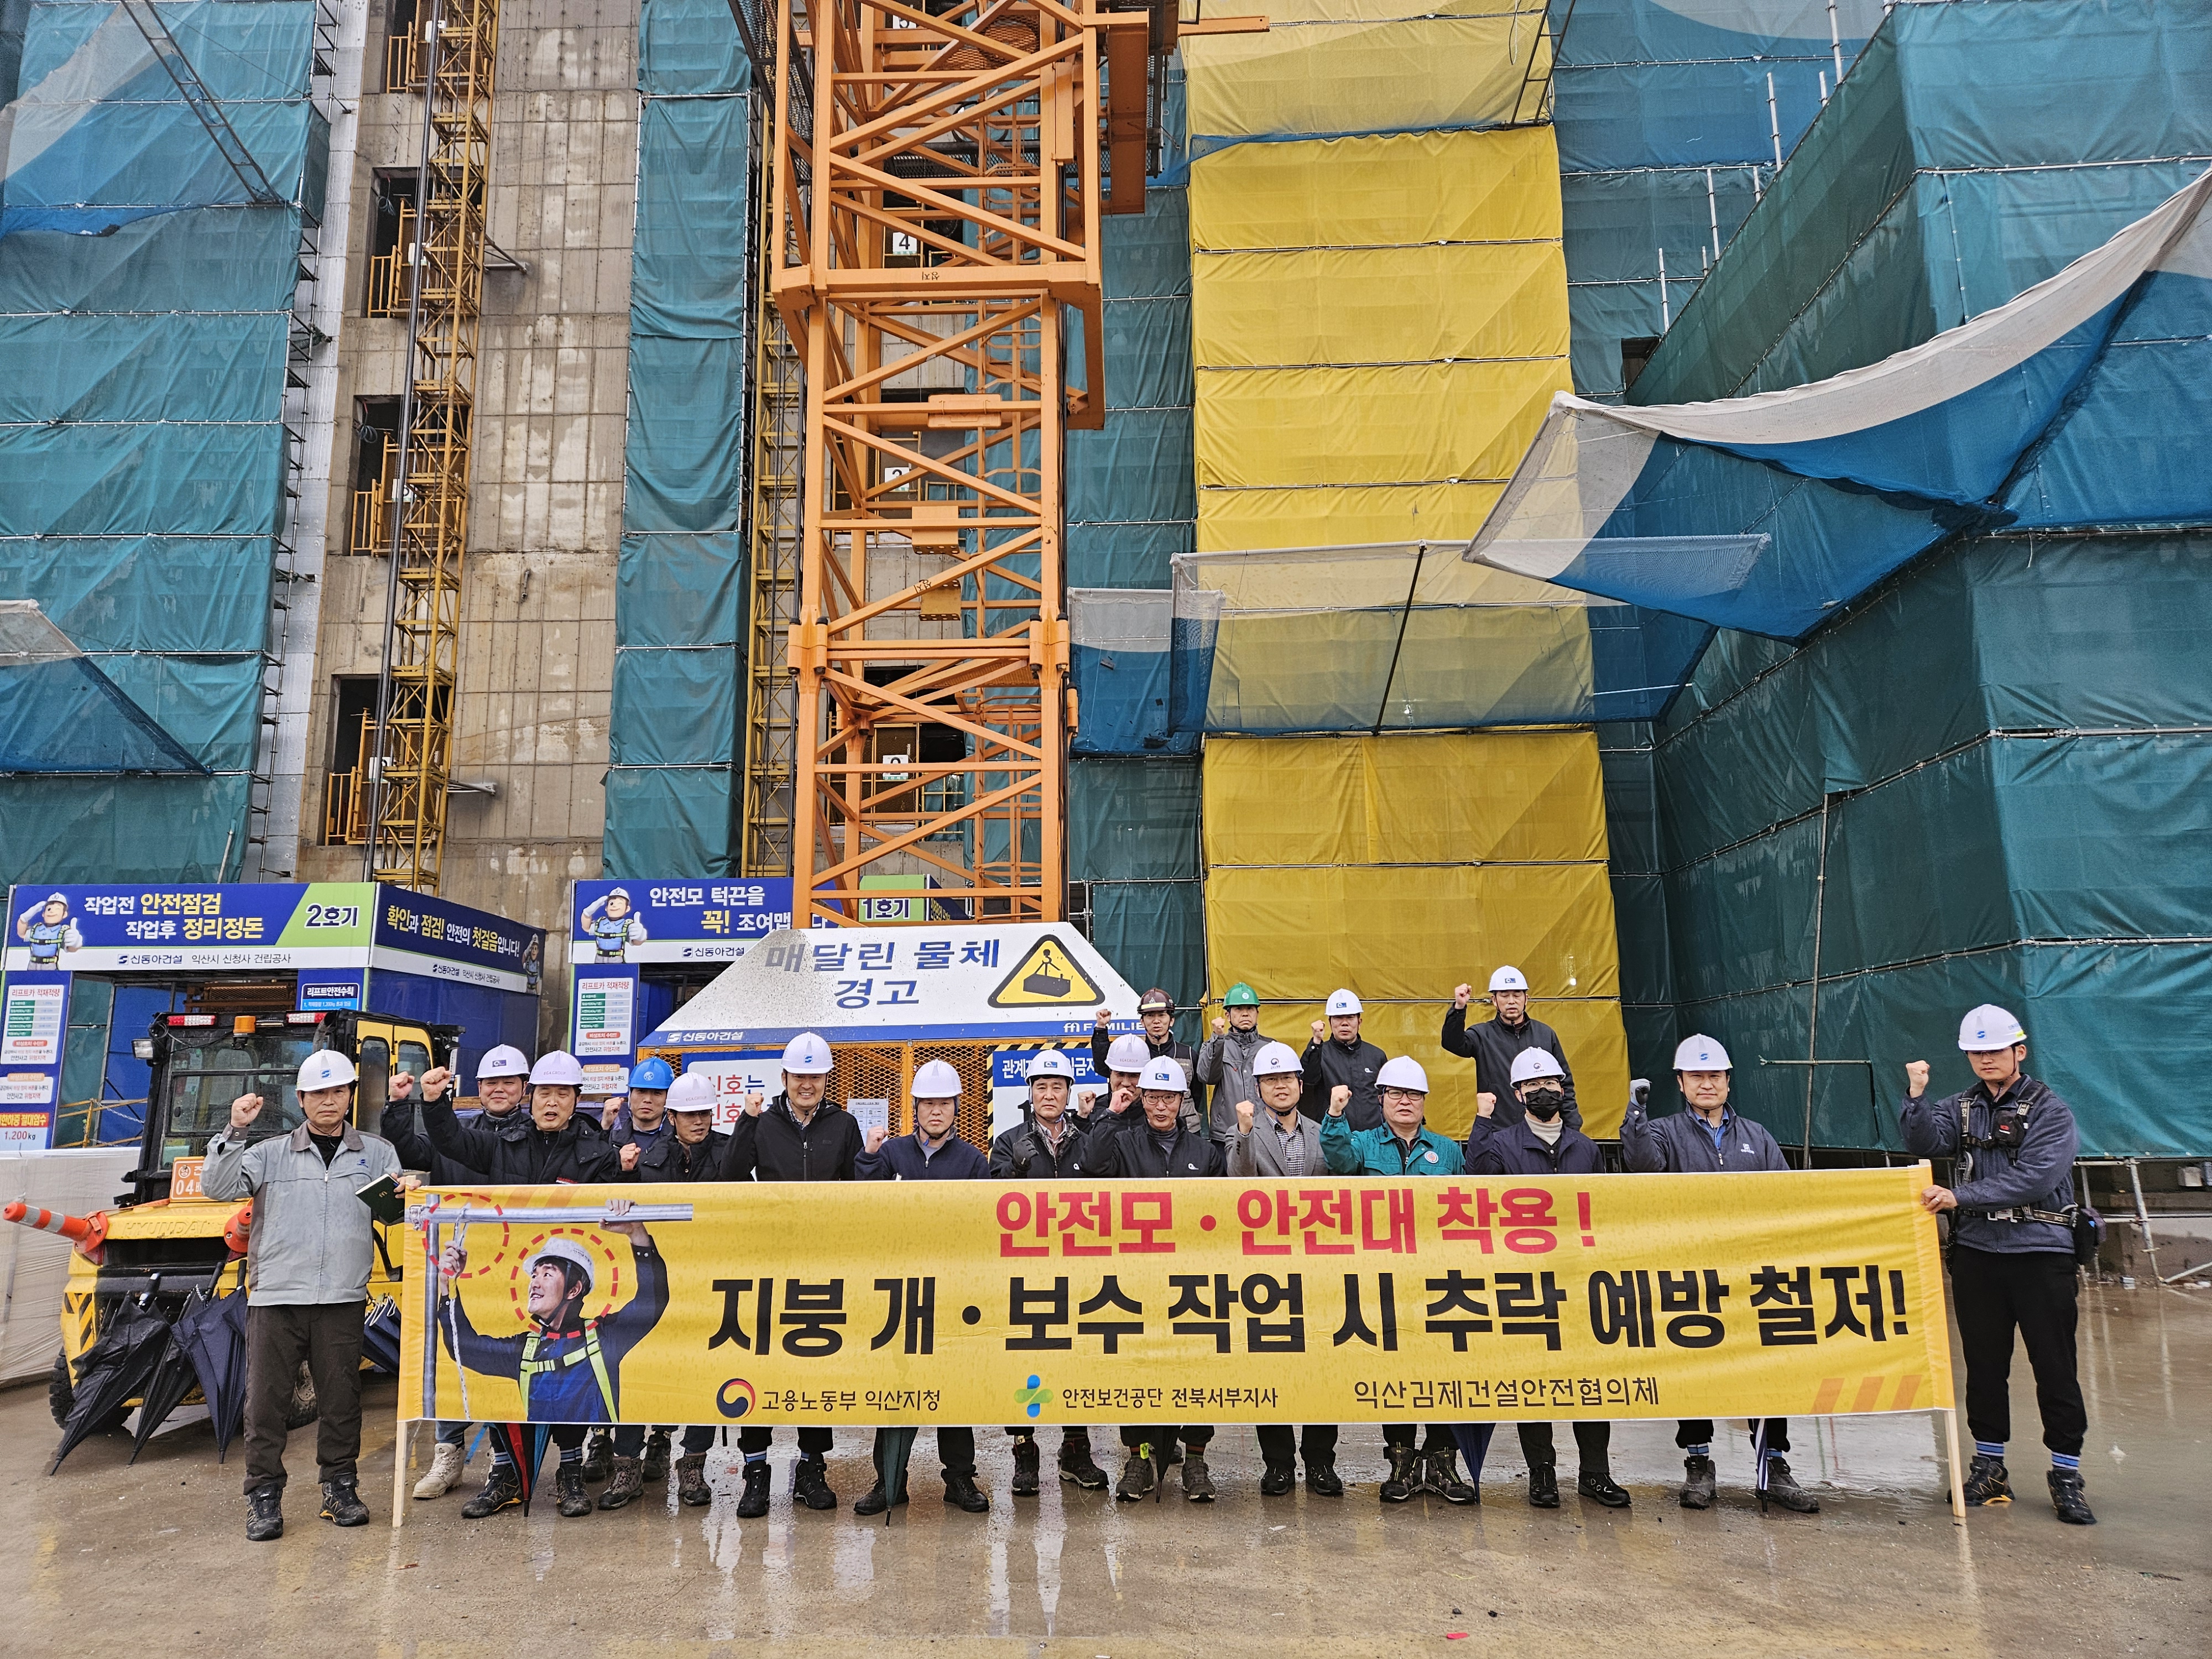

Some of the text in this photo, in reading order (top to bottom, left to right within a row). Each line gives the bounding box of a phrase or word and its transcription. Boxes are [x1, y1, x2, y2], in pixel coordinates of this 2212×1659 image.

[899, 234, 910, 250] 4
[84, 893, 221, 916] 작업전 안전점검
[650, 885, 765, 907] 안전모 턱끈을
[304, 902, 359, 930] 2호기
[860, 898, 911, 920] 1호기
[125, 917, 264, 940] 작업후 정리정돈
[387, 905, 520, 957] 확인과 점검! 안전의 첫걸음입니다!
[701, 910, 828, 934] 꼭! 조여맵다
[131, 953, 291, 965] 신동아건설 익산시 신청사 건립공사
[694, 947, 745, 957] 신동아건설
[765, 938, 1000, 973] 매달린 물체
[437, 965, 460, 977] 신동아건설
[462, 969, 474, 979] 익산시
[12, 988, 35, 997] 리프트카
[307, 986, 354, 997] 리프트안전수칙
[582, 982, 605, 990] 리프트카
[833, 979, 920, 1009] 경고
[682, 1031, 743, 1042] 신동아건설
[1083, 1022, 1146, 1031] FMILIE
[0, 1114, 20, 1126] 한하중
[123, 1220, 207, 1236] HYUNDAI
[995, 1191, 1176, 1258] 안전모
[1237, 1188, 1417, 1256] 안전대
[1437, 1186, 1597, 1255] 착용!
[707, 1277, 847, 1358] 지붕
[870, 1276, 936, 1355] 개
[1005, 1274, 1145, 1355] 보수
[1168, 1273, 1306, 1354] 작업
[1333, 1272, 1399, 1352] 시
[1425, 1269, 1567, 1352] 추락
[1588, 1268, 1730, 1349] 예방
[1749, 1264, 1910, 1346] 철저!
[761, 1389, 941, 1412] 고용노동부 익산지청
[1062, 1386, 1279, 1410] 안전보건공단 전북서부지사
[1353, 1376, 1660, 1410] 익산김제건설안전협의체
